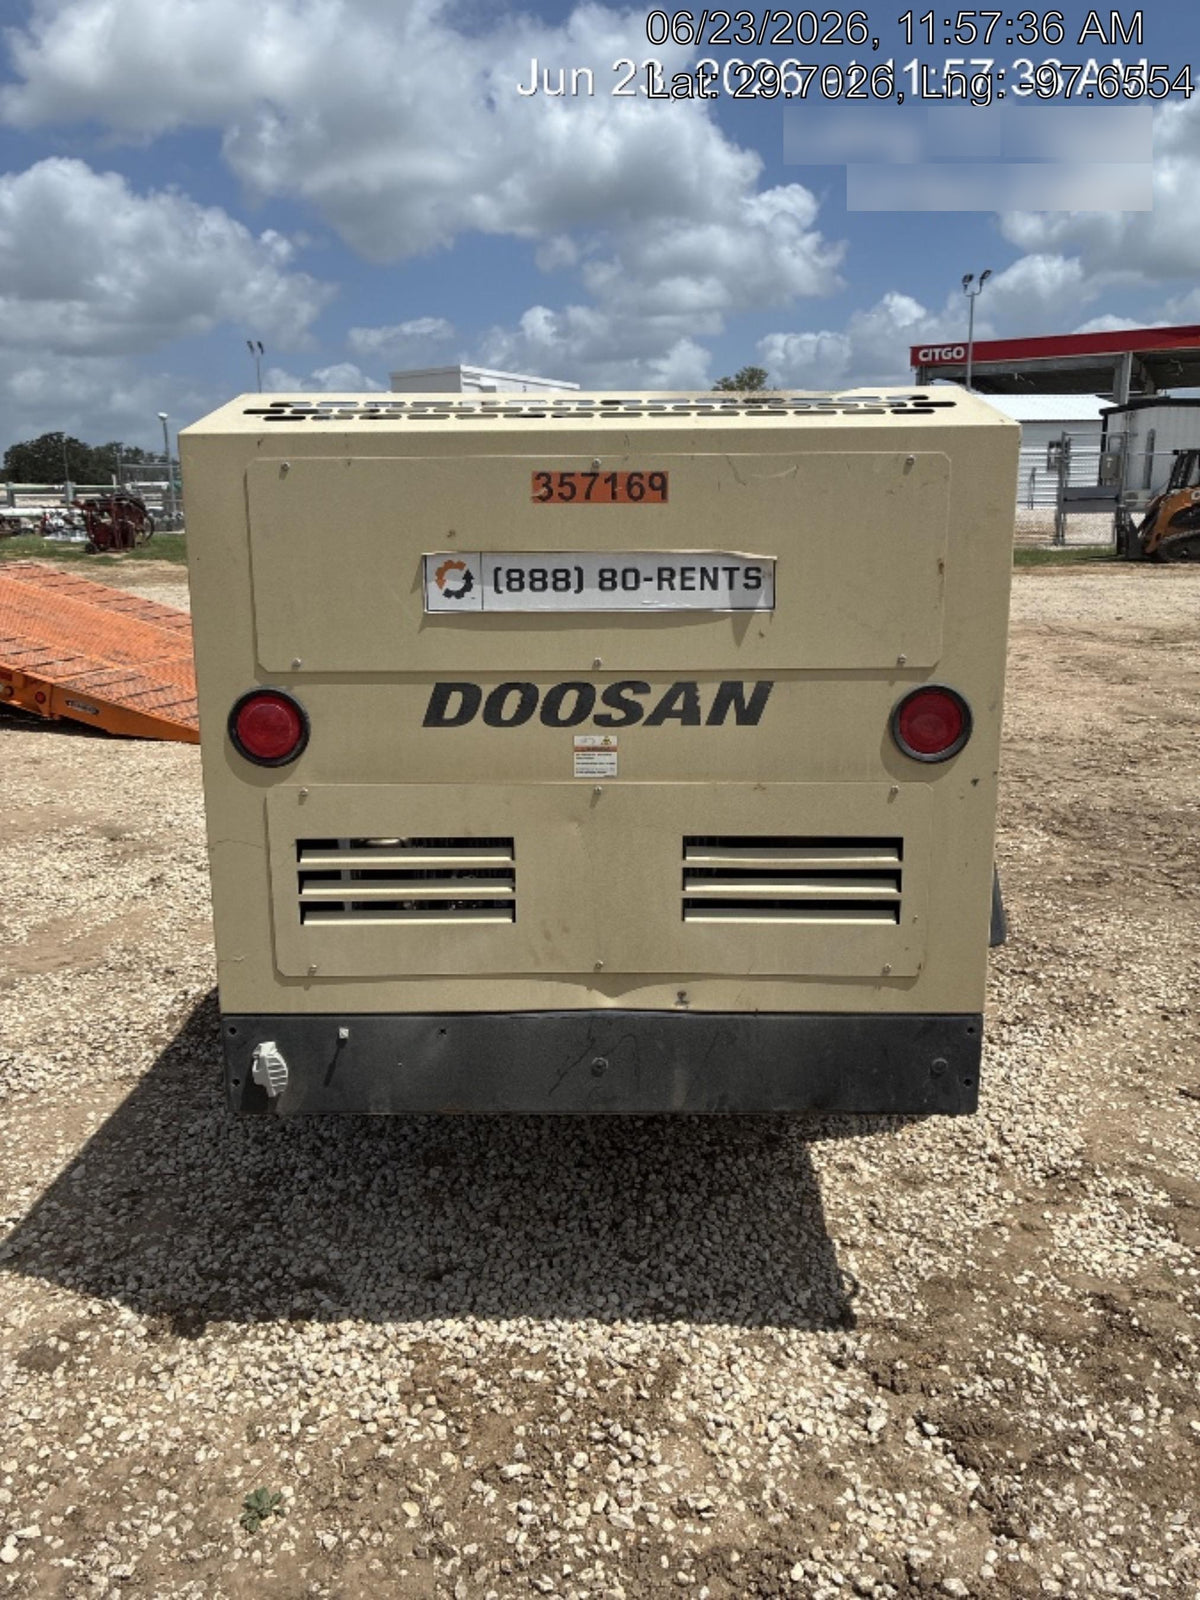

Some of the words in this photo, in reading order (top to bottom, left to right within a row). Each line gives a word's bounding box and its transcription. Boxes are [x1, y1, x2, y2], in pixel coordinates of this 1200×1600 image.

[919, 346, 965, 361] CITGO
[534, 472, 668, 501] 357169
[493, 566, 584, 594] (888)
[598, 566, 762, 592] 80-RENTS
[422, 680, 775, 728] DOOSAN
